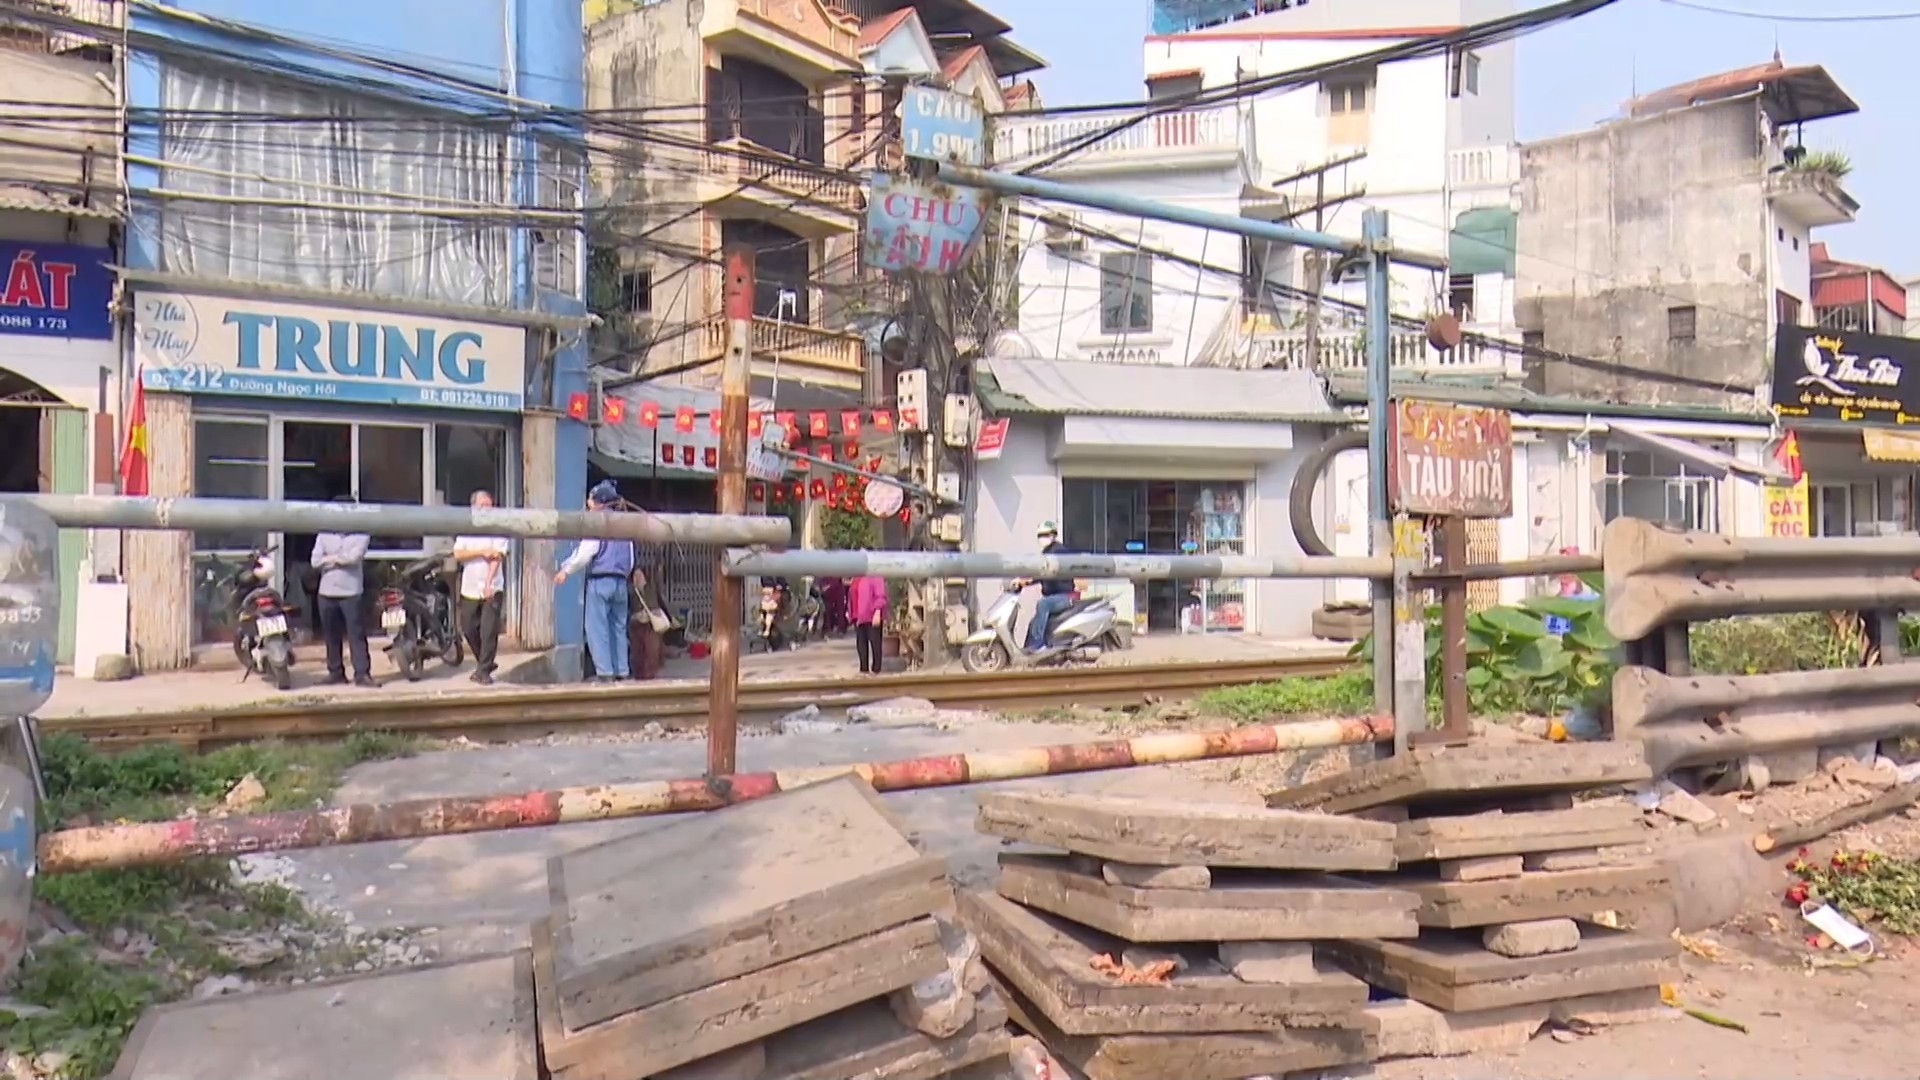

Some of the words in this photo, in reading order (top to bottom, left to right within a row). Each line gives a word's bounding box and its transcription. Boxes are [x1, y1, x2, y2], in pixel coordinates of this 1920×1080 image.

[0, 250, 76, 310] ÁT
[38, 317, 68, 329] 173
[222, 310, 486, 385] TRUNG
[182, 361, 225, 389] 212
